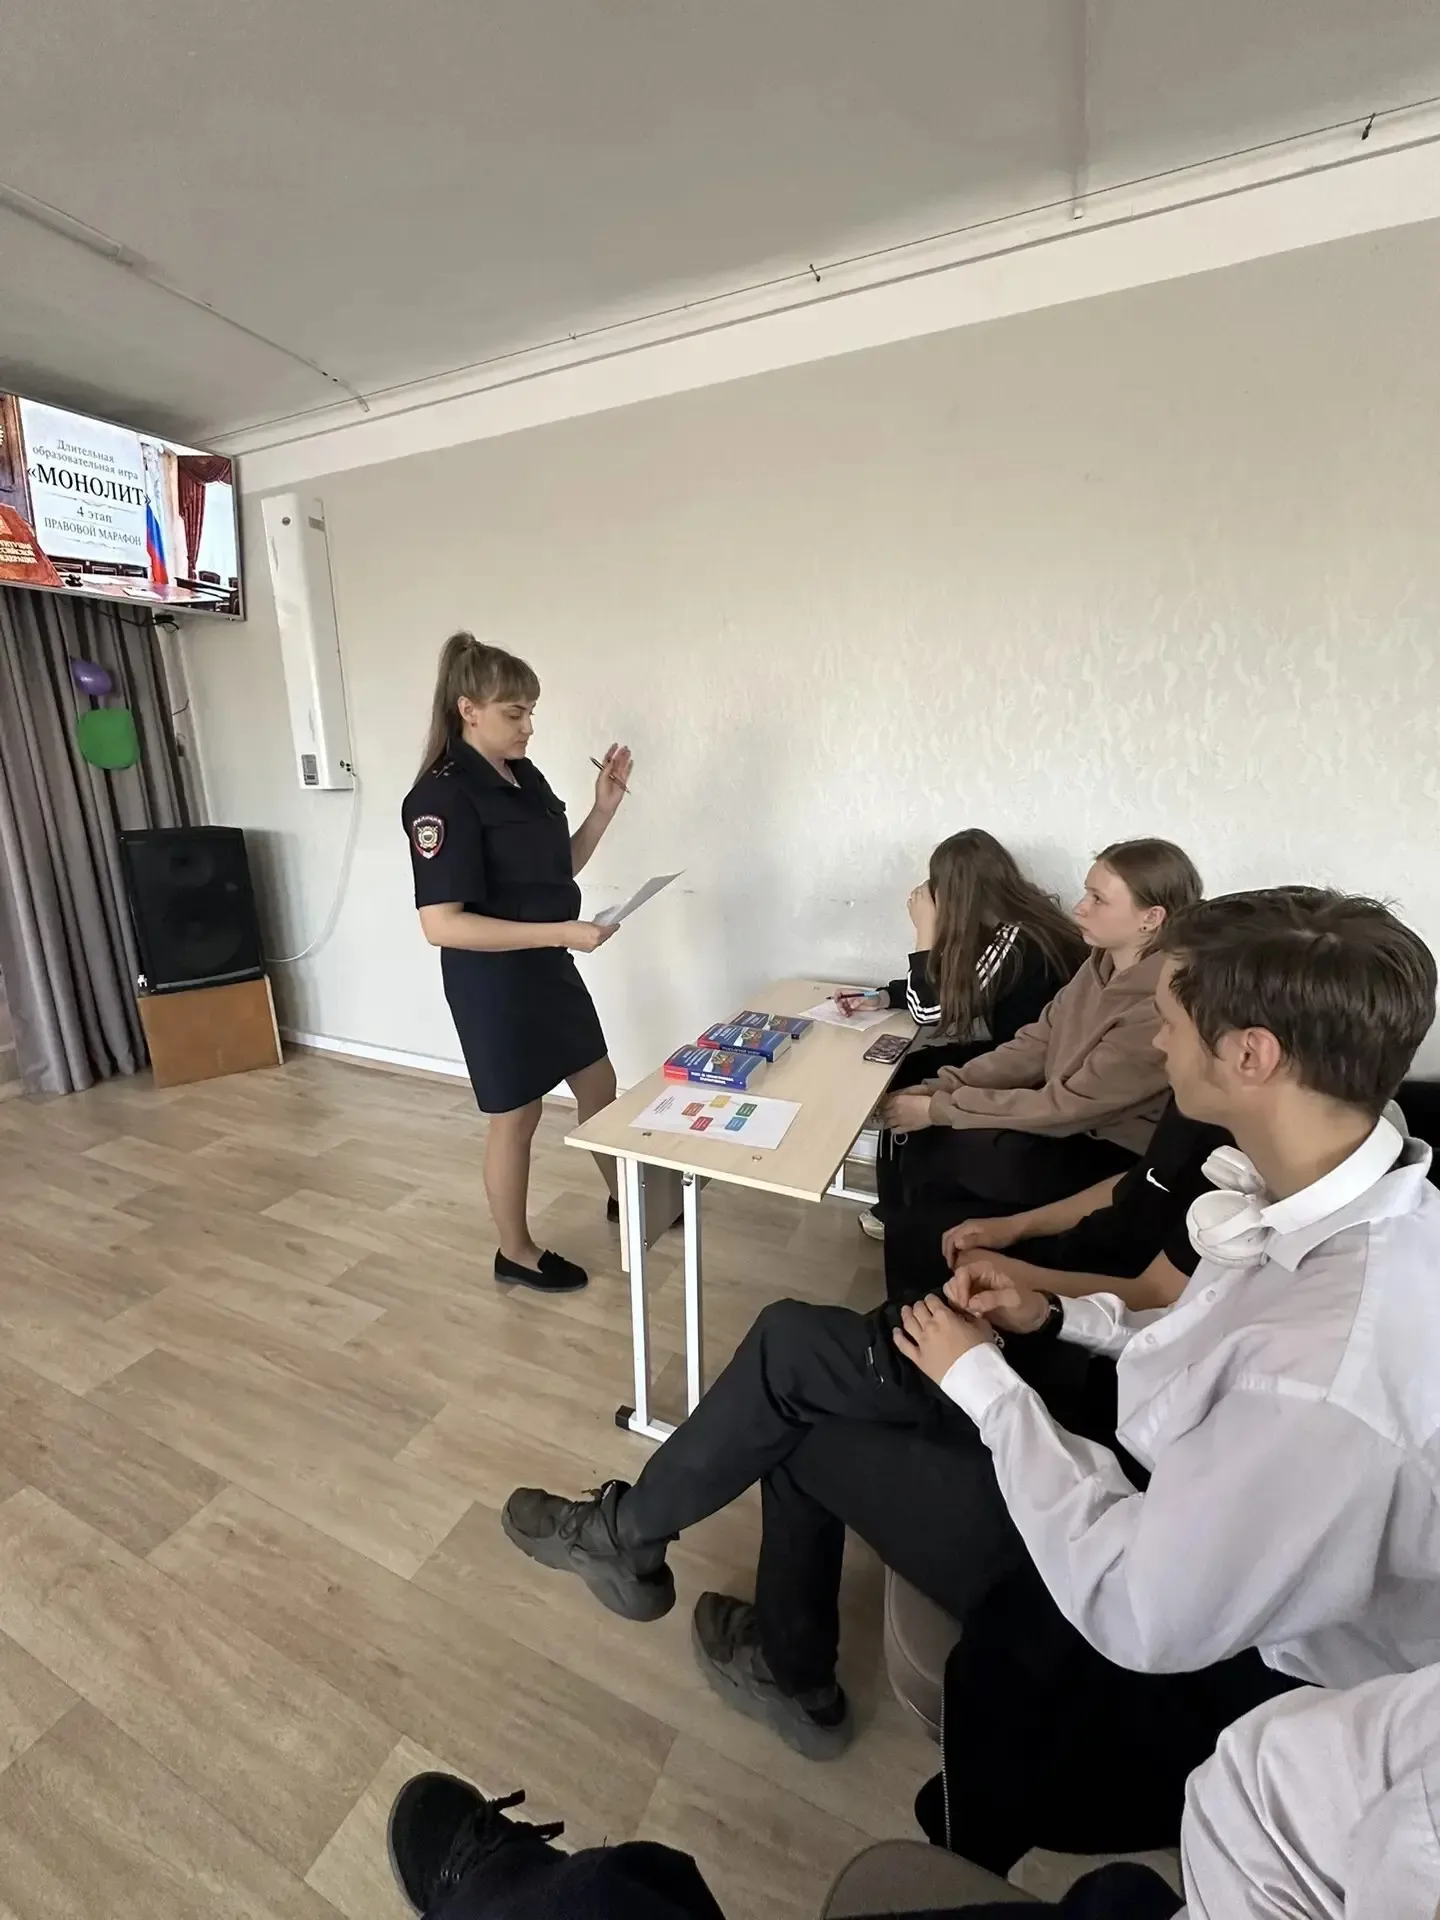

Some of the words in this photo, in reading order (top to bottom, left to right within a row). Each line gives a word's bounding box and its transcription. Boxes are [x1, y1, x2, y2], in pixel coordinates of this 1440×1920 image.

[32, 445, 116, 472] образовательная
[117, 468, 139, 480] игра
[57, 439, 114, 463] Длительная
[27, 463, 151, 506] «МОНОЛИТ»
[76, 506, 84, 518] 4
[88, 511, 112, 524] этап
[44, 517, 96, 537] ПРАВОВОЙ
[98, 528, 142, 546] МАРАФОН
